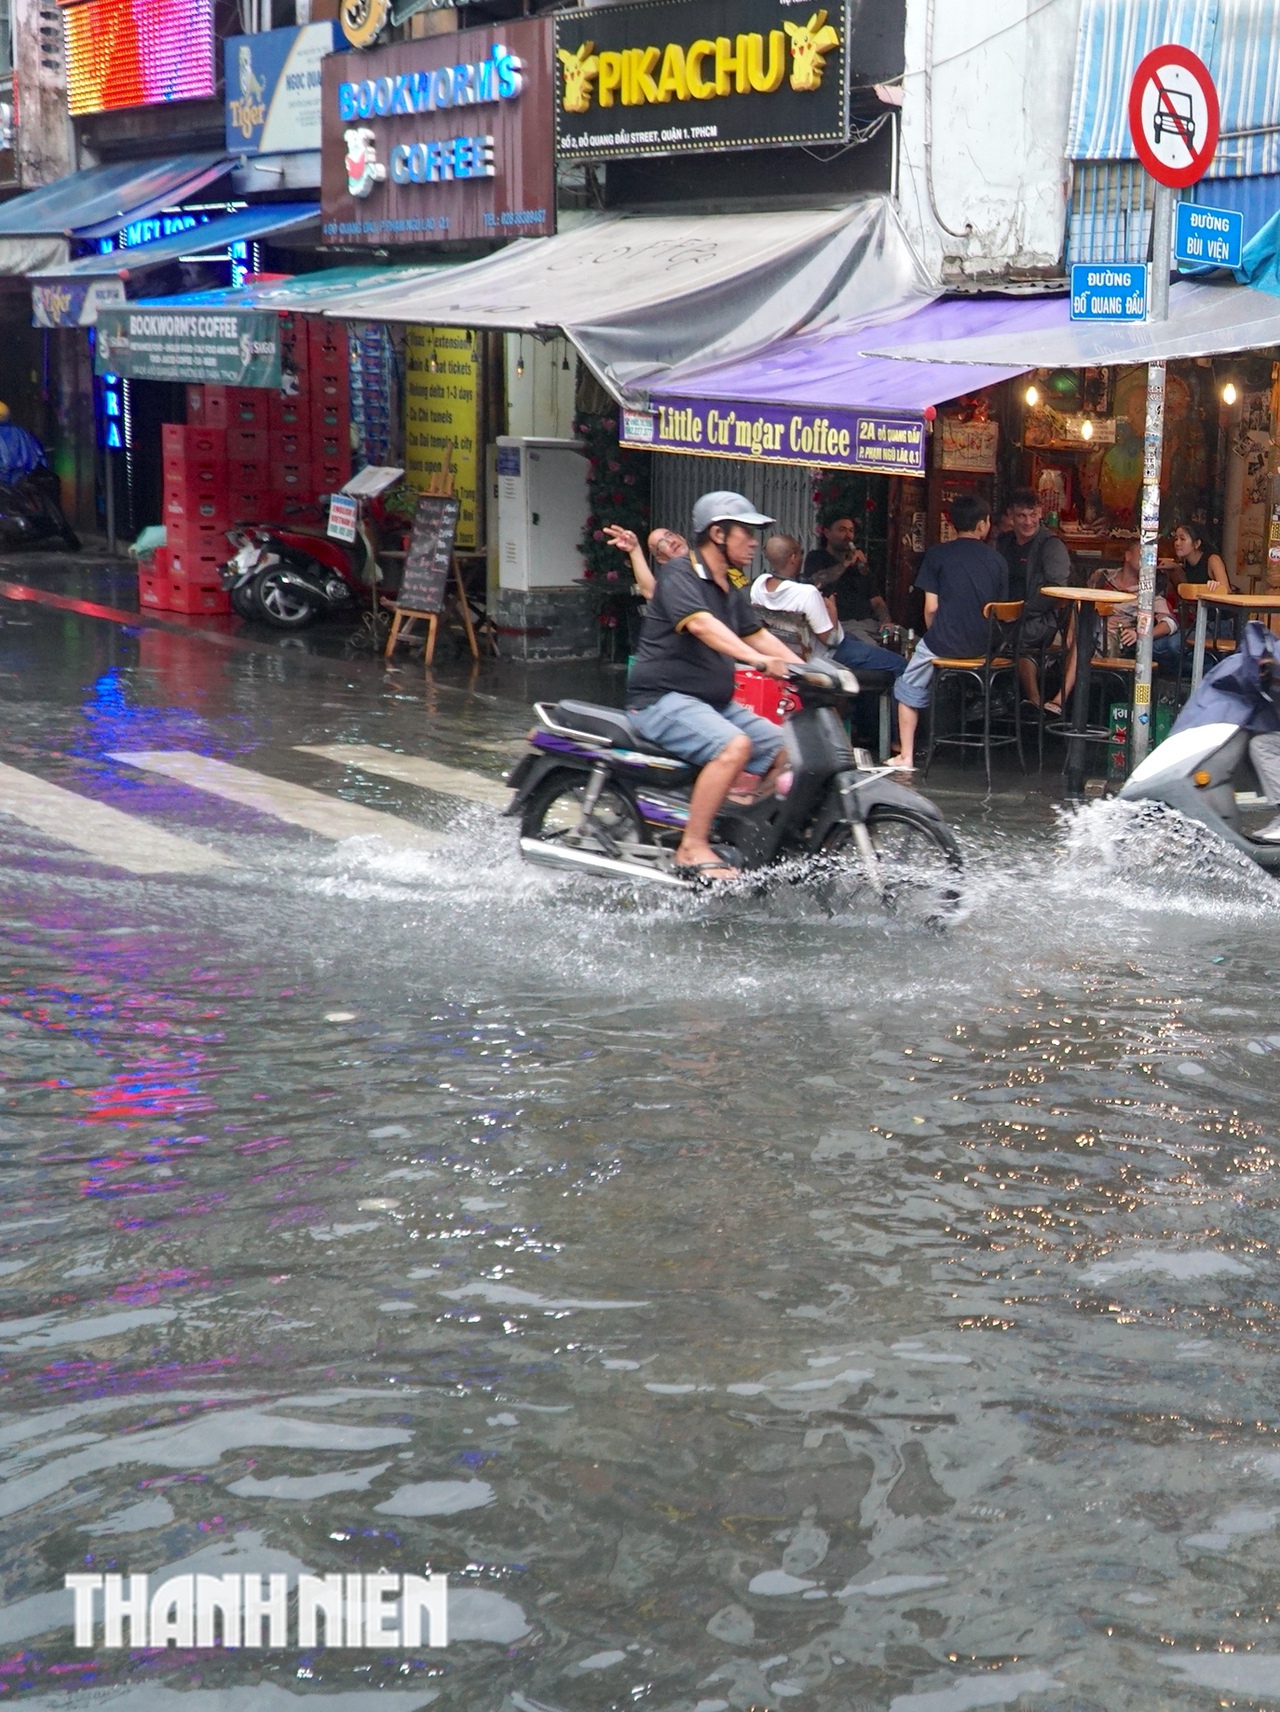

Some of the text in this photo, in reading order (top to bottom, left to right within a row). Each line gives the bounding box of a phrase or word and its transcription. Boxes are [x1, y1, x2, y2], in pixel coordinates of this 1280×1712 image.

[599, 30, 785, 108] PIKACHU
[339, 43, 524, 121] BOOKWORM'S
[229, 97, 265, 139] Tiger
[561, 134, 571, 148] SỐ
[590, 134, 614, 146] QUANG
[691, 125, 718, 138] TPHCM
[391, 135, 495, 184] COFFEE
[1190, 212, 1230, 232] ĐƯỜNG
[1187, 233, 1229, 263] BÙI VIỆN
[1087, 269, 1132, 287] ĐƯỜNG
[1073, 290, 1144, 315] ĐỖ QUANG ĐẨU
[130, 315, 238, 339] BOOKWORM'S COFFEE
[448, 361, 472, 375] tickets
[459, 386, 473, 403] days
[418, 407, 429, 422] Chi
[658, 405, 702, 443] Little
[789, 416, 851, 457] Coffee
[859, 421, 876, 440] 2A
[887, 428, 907, 443] QUANG
[460, 436, 472, 453] city
